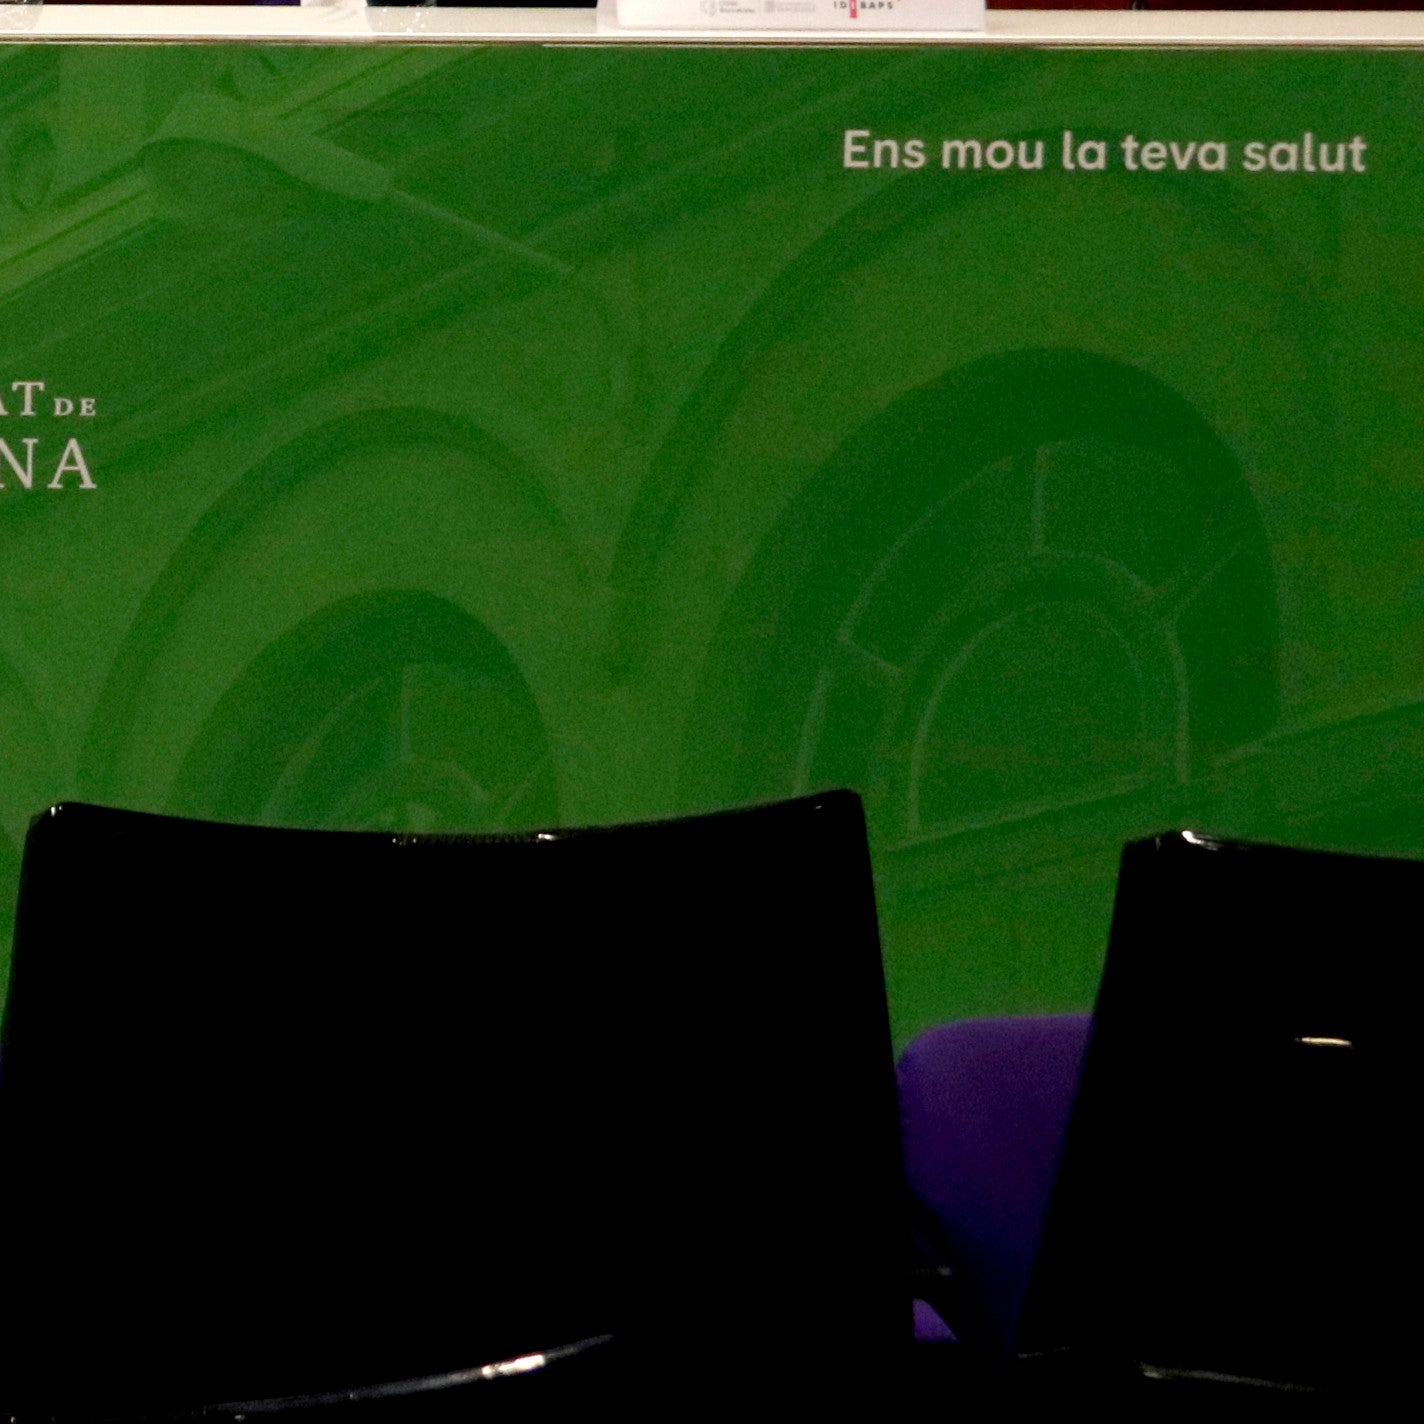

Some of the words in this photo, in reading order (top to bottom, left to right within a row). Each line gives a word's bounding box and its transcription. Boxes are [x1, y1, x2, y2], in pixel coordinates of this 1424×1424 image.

[844, 129, 926, 169] Ens
[942, 139, 1043, 170] mou
[1063, 130, 1106, 170] la
[1122, 134, 1226, 171] teva
[1244, 131, 1366, 172] salut
